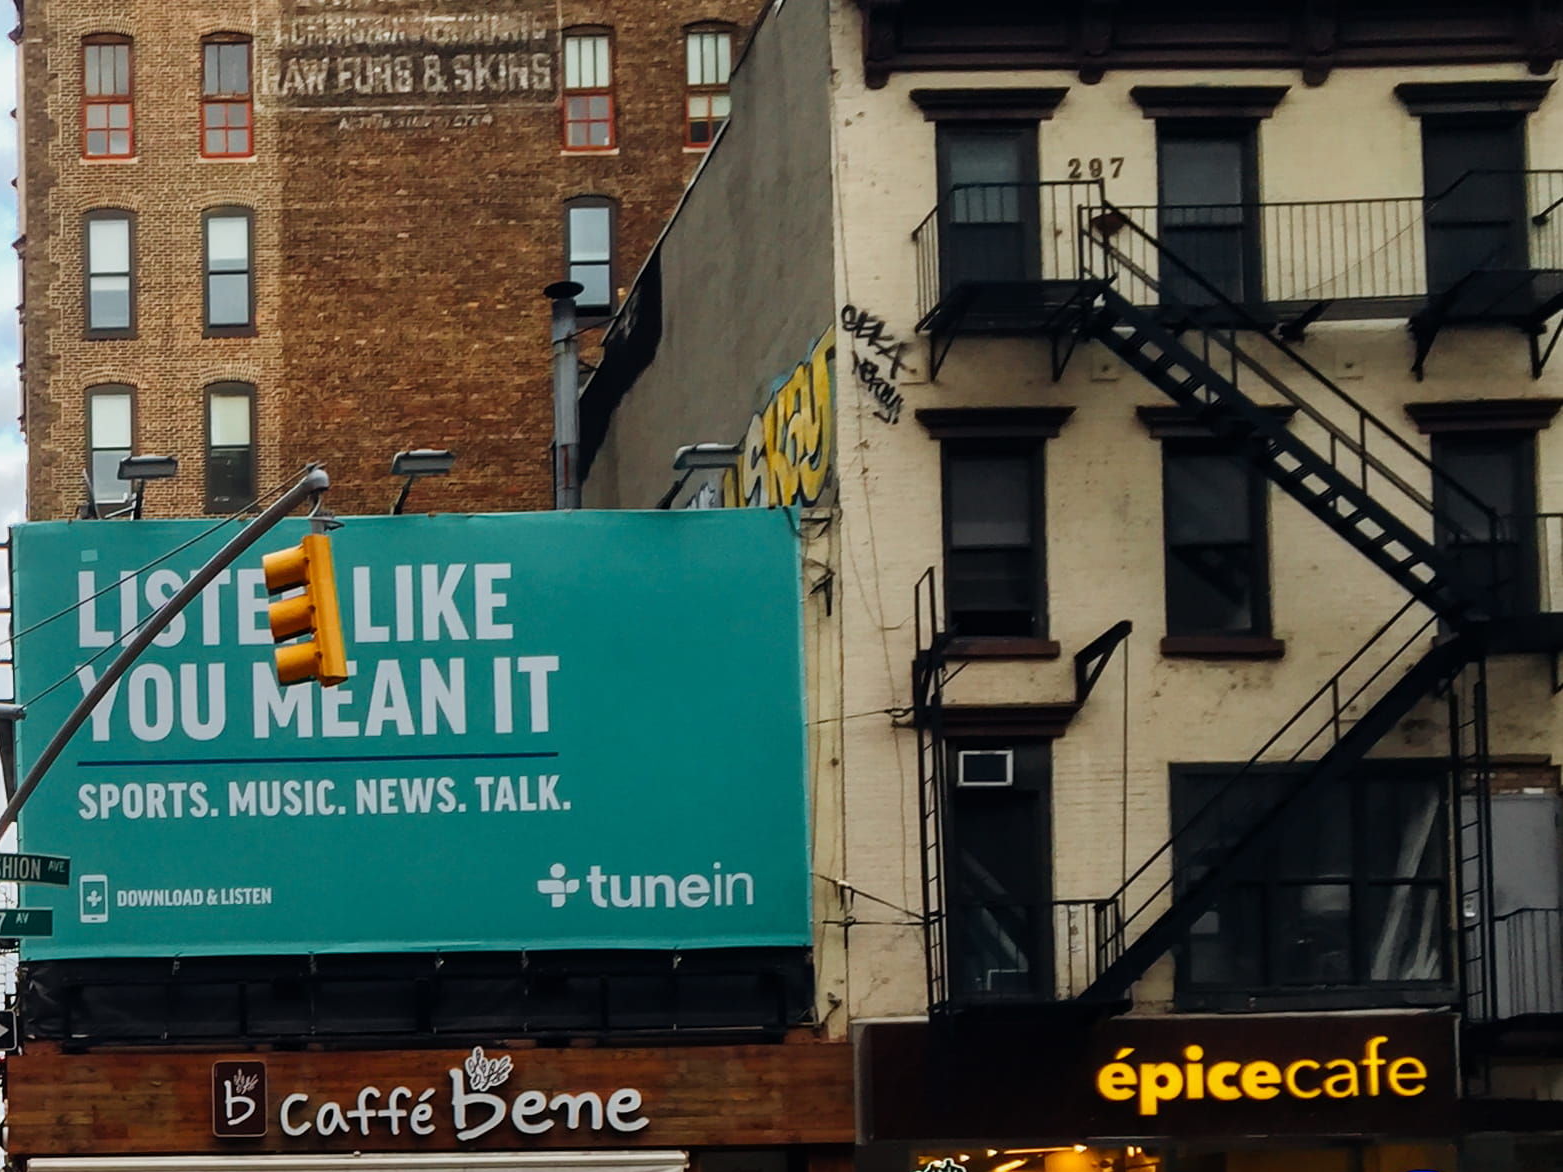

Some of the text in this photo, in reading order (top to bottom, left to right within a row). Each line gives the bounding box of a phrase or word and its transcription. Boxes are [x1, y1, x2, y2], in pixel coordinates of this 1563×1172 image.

[1067, 157, 1125, 179] 297
[77, 563, 514, 649] LISTE LIKE
[74, 655, 560, 742] YOU MEAN IT
[77, 774, 572, 820] SPORTS. MUSIC. NEWS. TALK.
[47, 860, 66, 873] AVE
[586, 862, 754, 910] tunein
[15, 913, 29, 924] AV
[116, 886, 273, 909] DOWNLOAD & LISTEN
[1095, 1035, 1428, 1116] épicecafe
